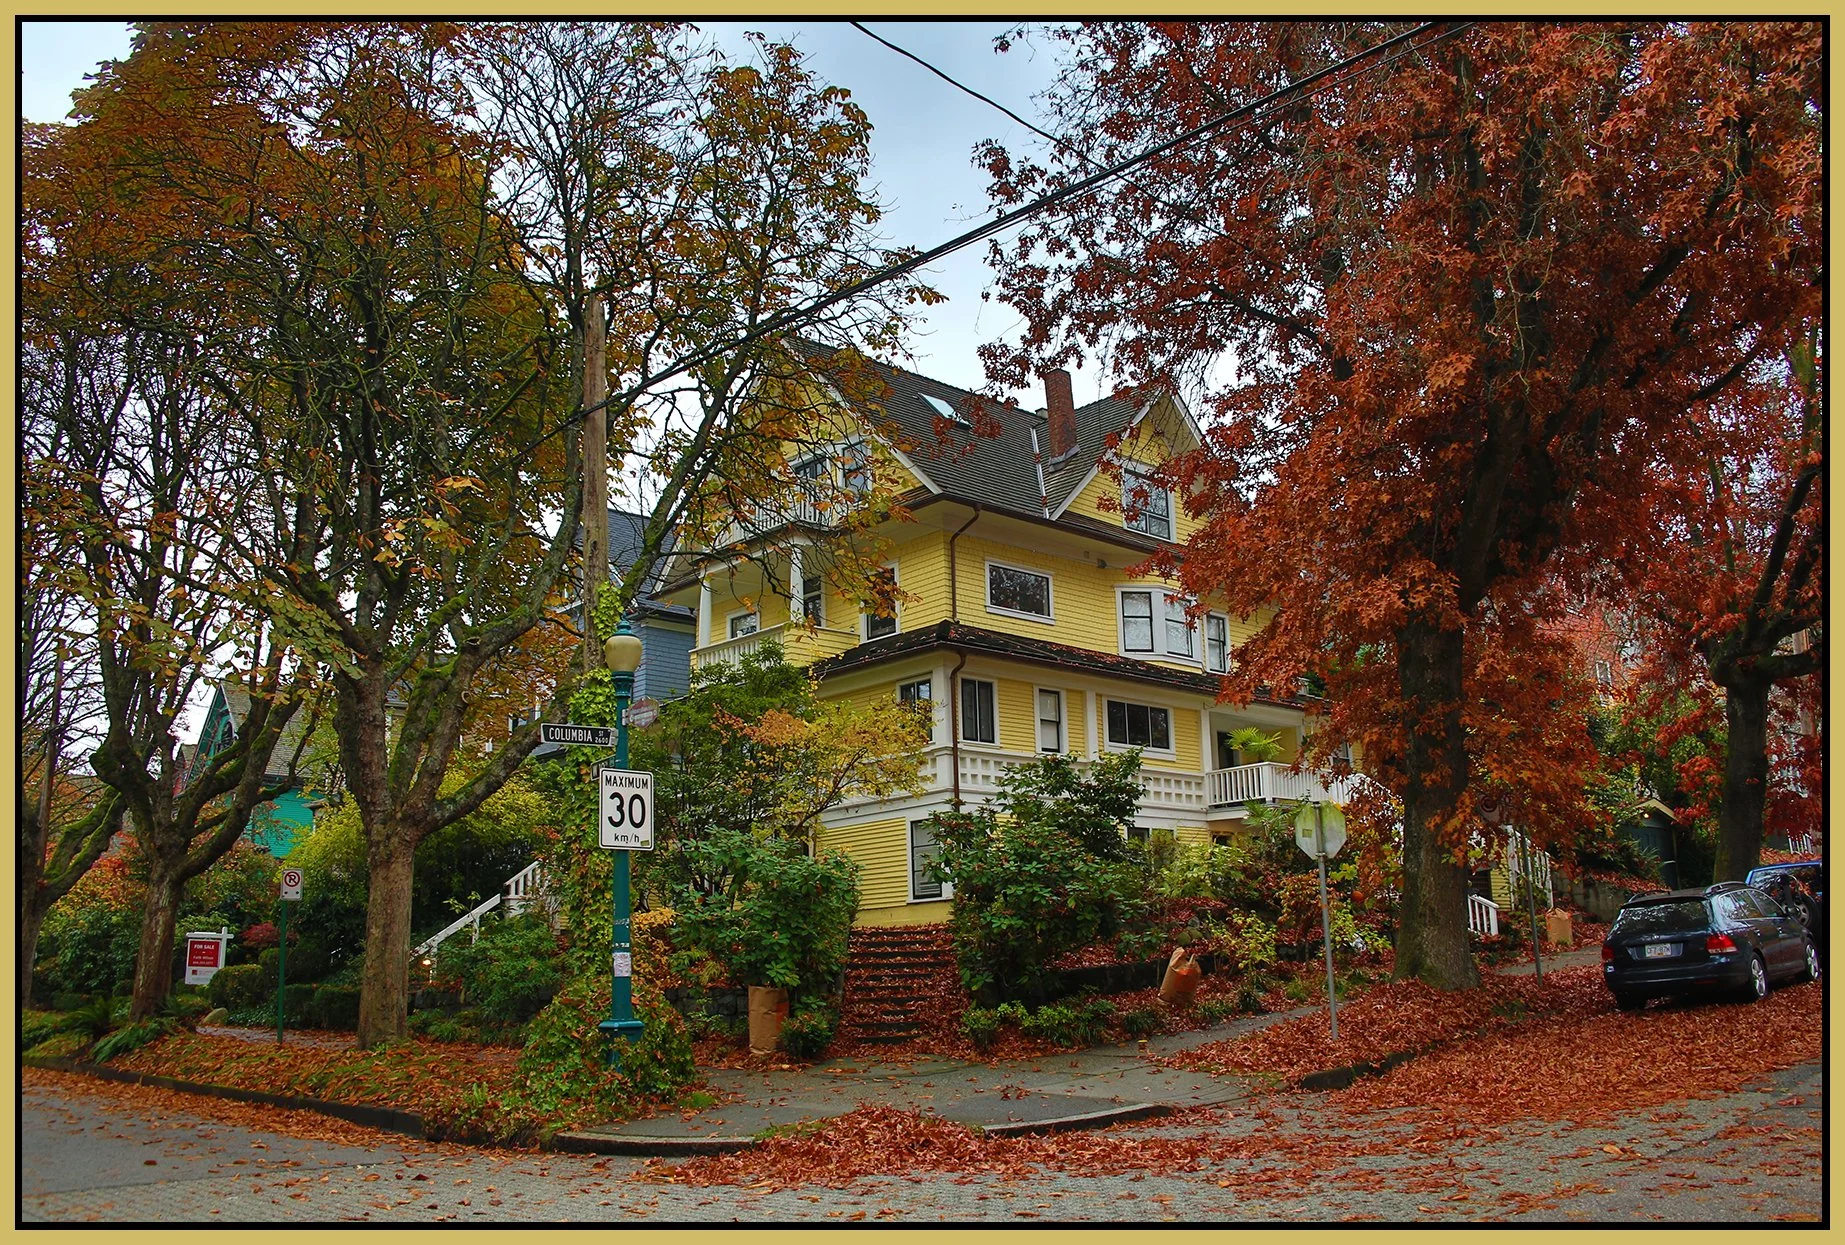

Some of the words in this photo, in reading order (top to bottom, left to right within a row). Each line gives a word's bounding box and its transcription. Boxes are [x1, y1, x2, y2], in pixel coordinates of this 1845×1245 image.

[548, 727, 593, 742] COLUMBIA
[605, 775, 649, 790] MAXIMUM
[608, 792, 646, 829] 30
[614, 833, 640, 843] km/h
